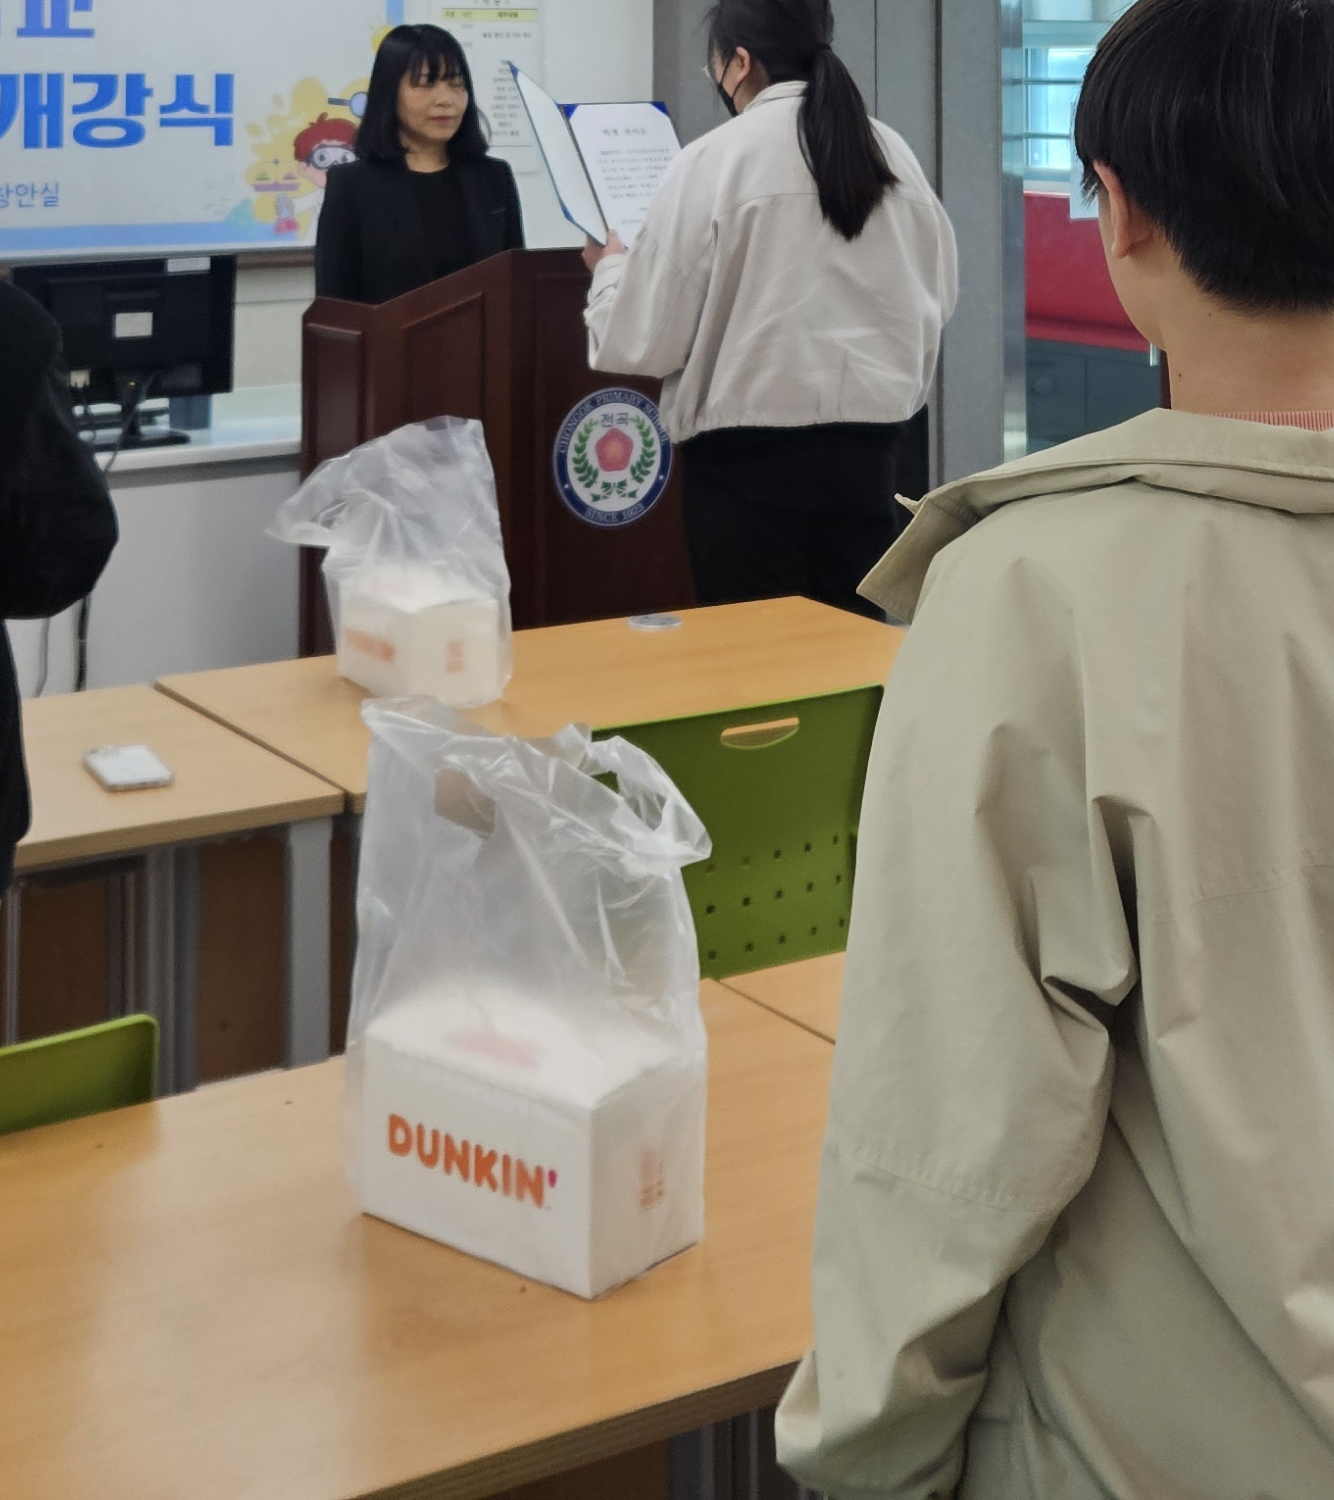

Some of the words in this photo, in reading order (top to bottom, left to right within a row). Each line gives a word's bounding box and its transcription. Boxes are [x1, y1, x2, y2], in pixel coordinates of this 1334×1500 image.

[559, 401, 595, 453] CHONGOK
[594, 391, 643, 409] PRIMARY
[600, 412, 630, 428] 전곡
[584, 506, 619, 522] SINCE
[622, 503, 645, 520] 1923
[387, 1113, 558, 1209] DUNKIN'
